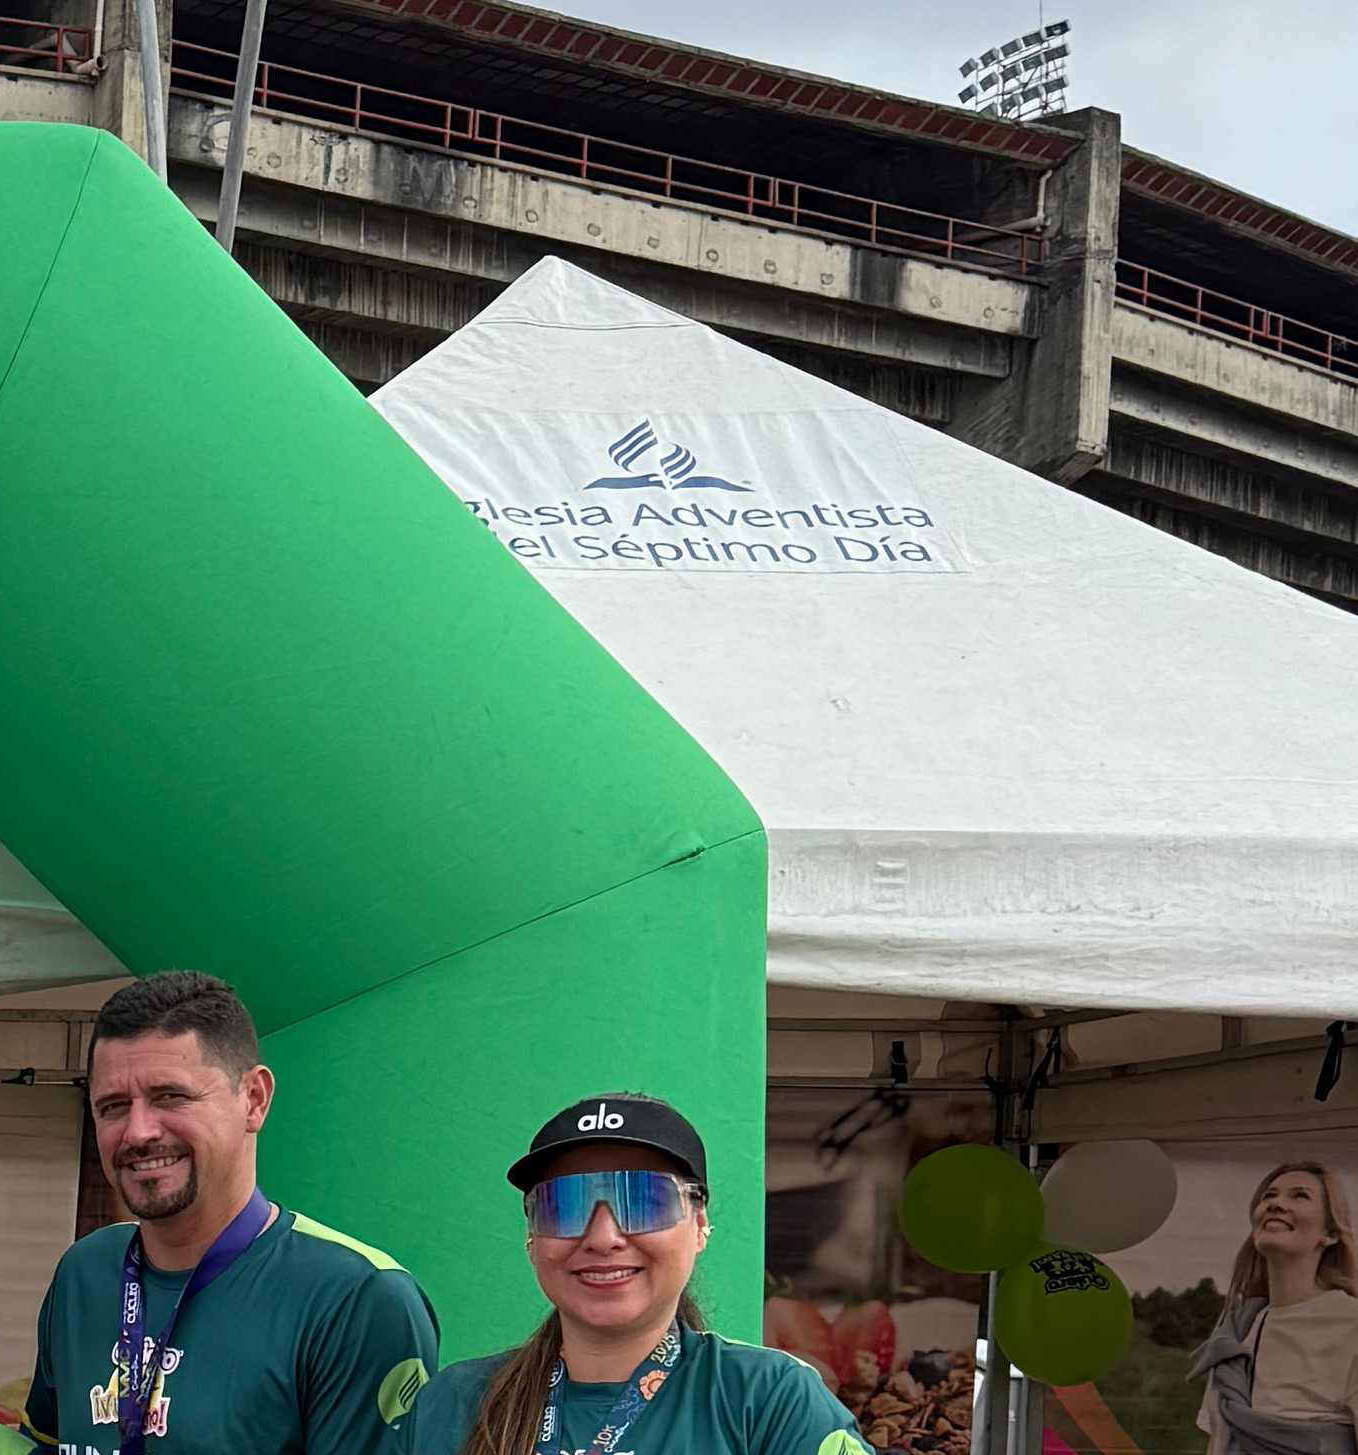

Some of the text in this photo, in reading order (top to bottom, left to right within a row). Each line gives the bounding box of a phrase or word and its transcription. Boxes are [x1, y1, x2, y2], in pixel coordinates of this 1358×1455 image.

[632, 502, 936, 530] Adventista
[491, 530, 934, 567] el Séptimo Día
[577, 1103, 624, 1132] alo
